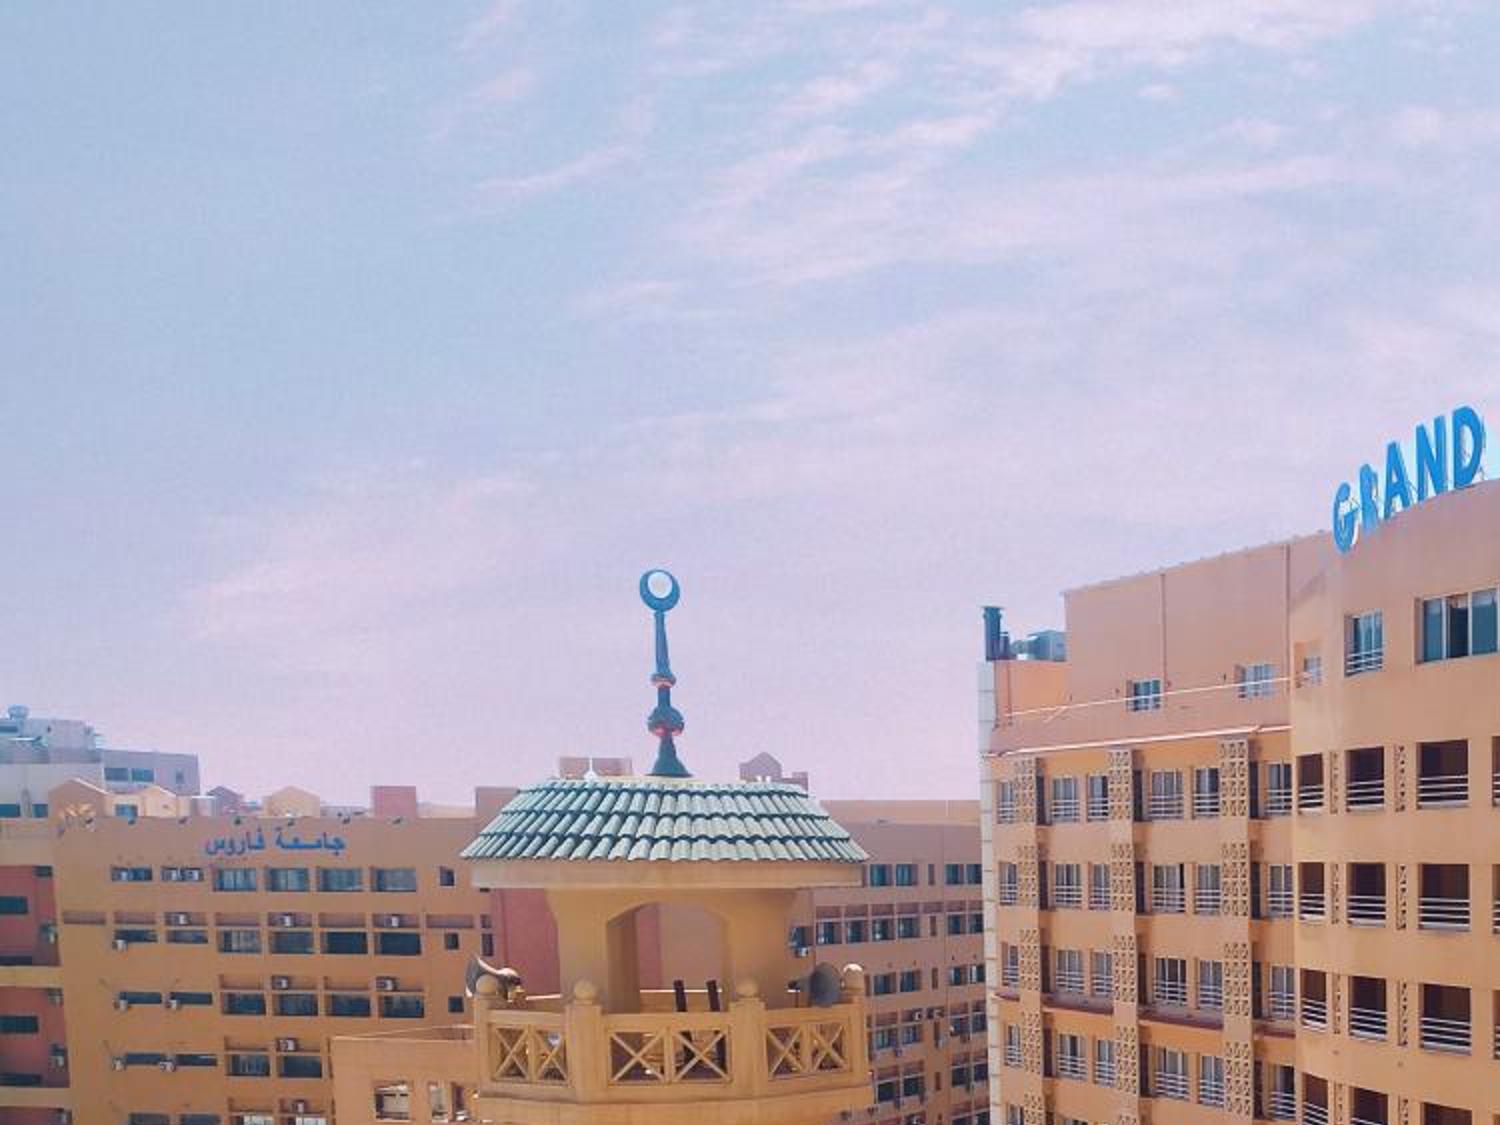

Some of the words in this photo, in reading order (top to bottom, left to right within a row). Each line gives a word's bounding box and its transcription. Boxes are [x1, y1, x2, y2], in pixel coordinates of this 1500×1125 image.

[1333, 405, 1485, 553] GRAND
[205, 827, 265, 855] فاروس
[275, 827, 346, 856] جامعة
